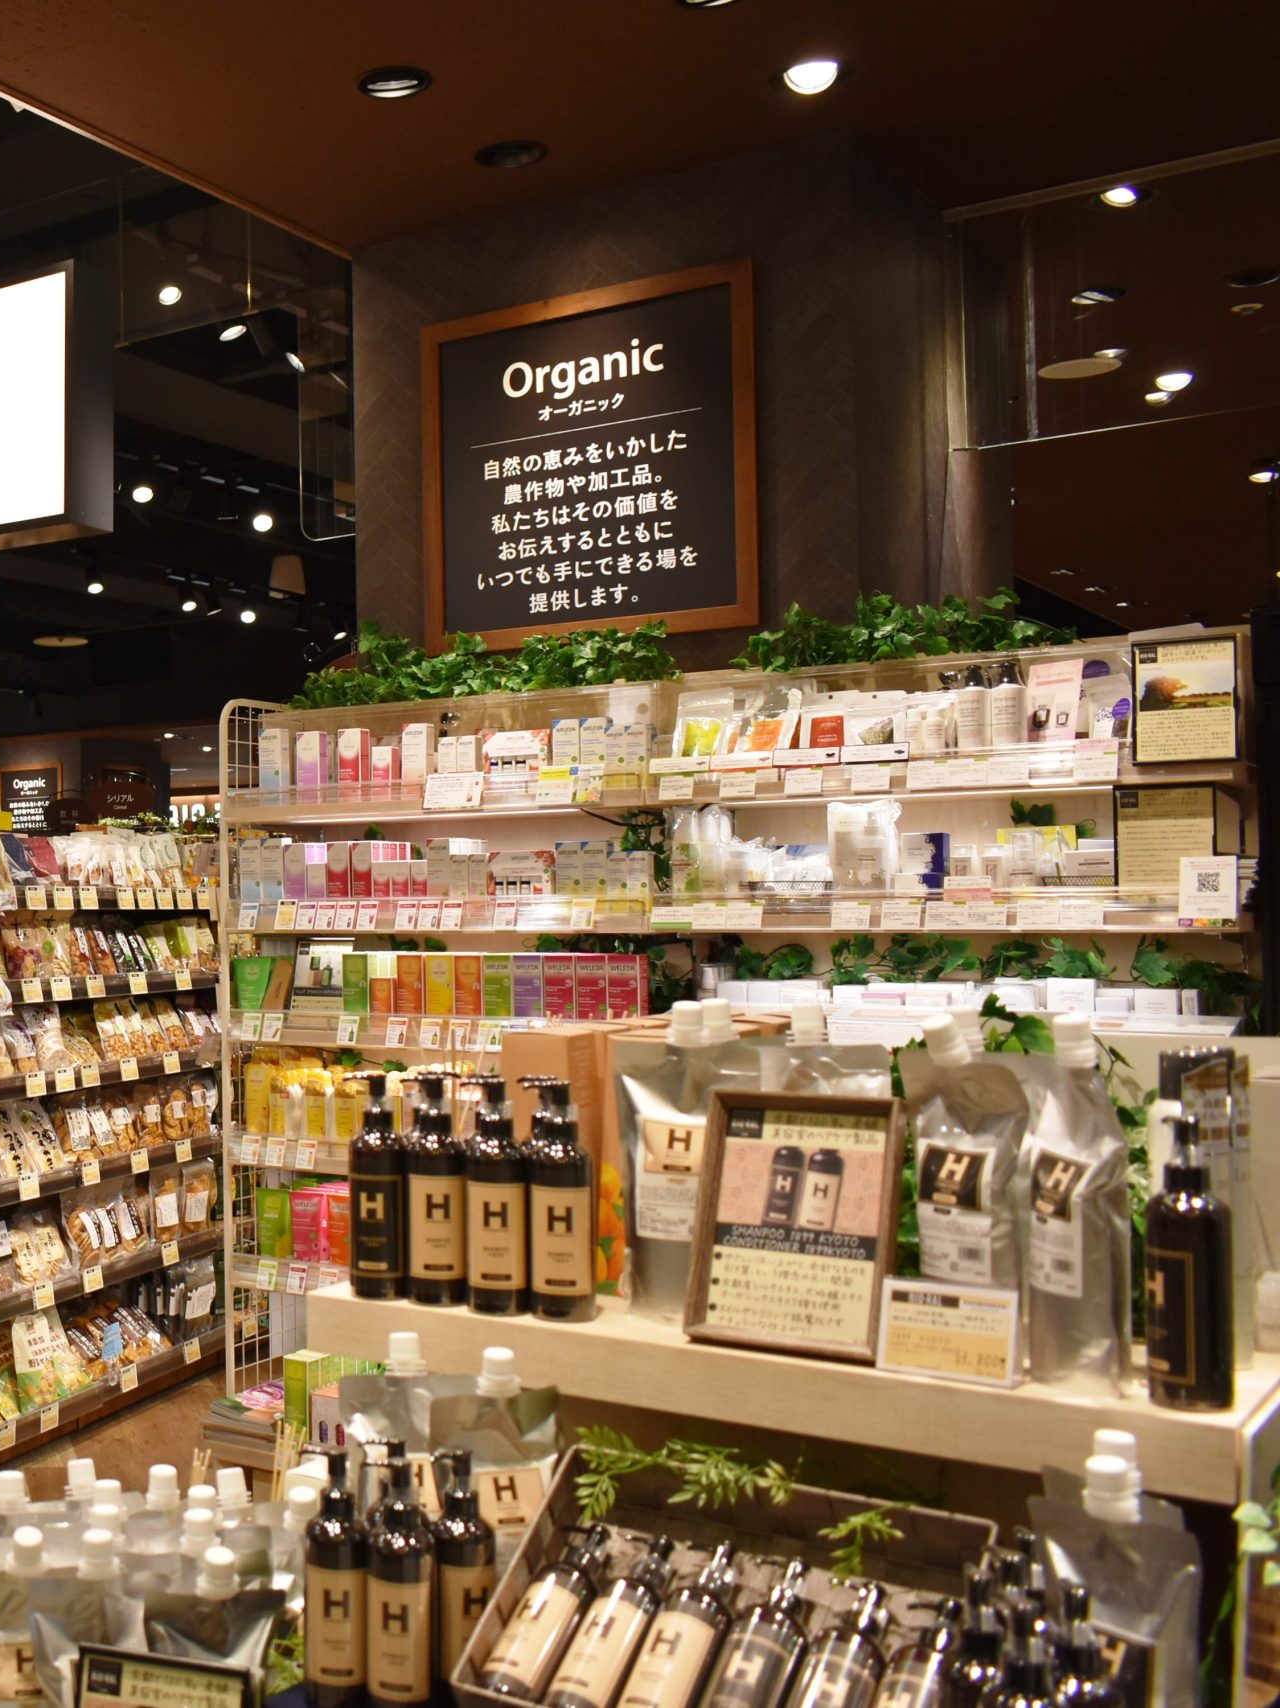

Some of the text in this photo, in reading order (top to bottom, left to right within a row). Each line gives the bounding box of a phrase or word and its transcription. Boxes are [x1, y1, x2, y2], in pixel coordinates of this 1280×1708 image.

[502, 338, 664, 399] Organic
[538, 393, 624, 421] オーガニック
[484, 429, 687, 481] 自然の恵みをいかした
[503, 464, 663, 505] 農作物や加工品。
[491, 489, 678, 534] 私たちはその価値を
[497, 520, 673, 560] お伝えするとともに
[477, 545, 698, 590] いつでも手にできる場を
[529, 583, 640, 613] 提供します。
[13, 777, 46, 791] Organic
[106, 794, 134, 803] シリアル
[668, 1128, 692, 1152] H
[938, 1152, 970, 1182] H
[1048, 1161, 1077, 1192] H
[776, 1174, 792, 1192] H
[813, 1183, 829, 1198] H
[360, 1192, 384, 1220] H
[425, 1193, 450, 1220] H
[483, 1201, 507, 1228] H
[547, 1206, 573, 1233] H
[819, 1233, 860, 1247] KYOTO
[492, 1475, 518, 1502] H
[323, 1587, 350, 1620] H
[462, 1587, 488, 1617] H
[382, 1600, 409, 1634] H
[585, 1613, 617, 1642] H
[650, 1629, 683, 1658] H
[728, 1649, 759, 1686] H
